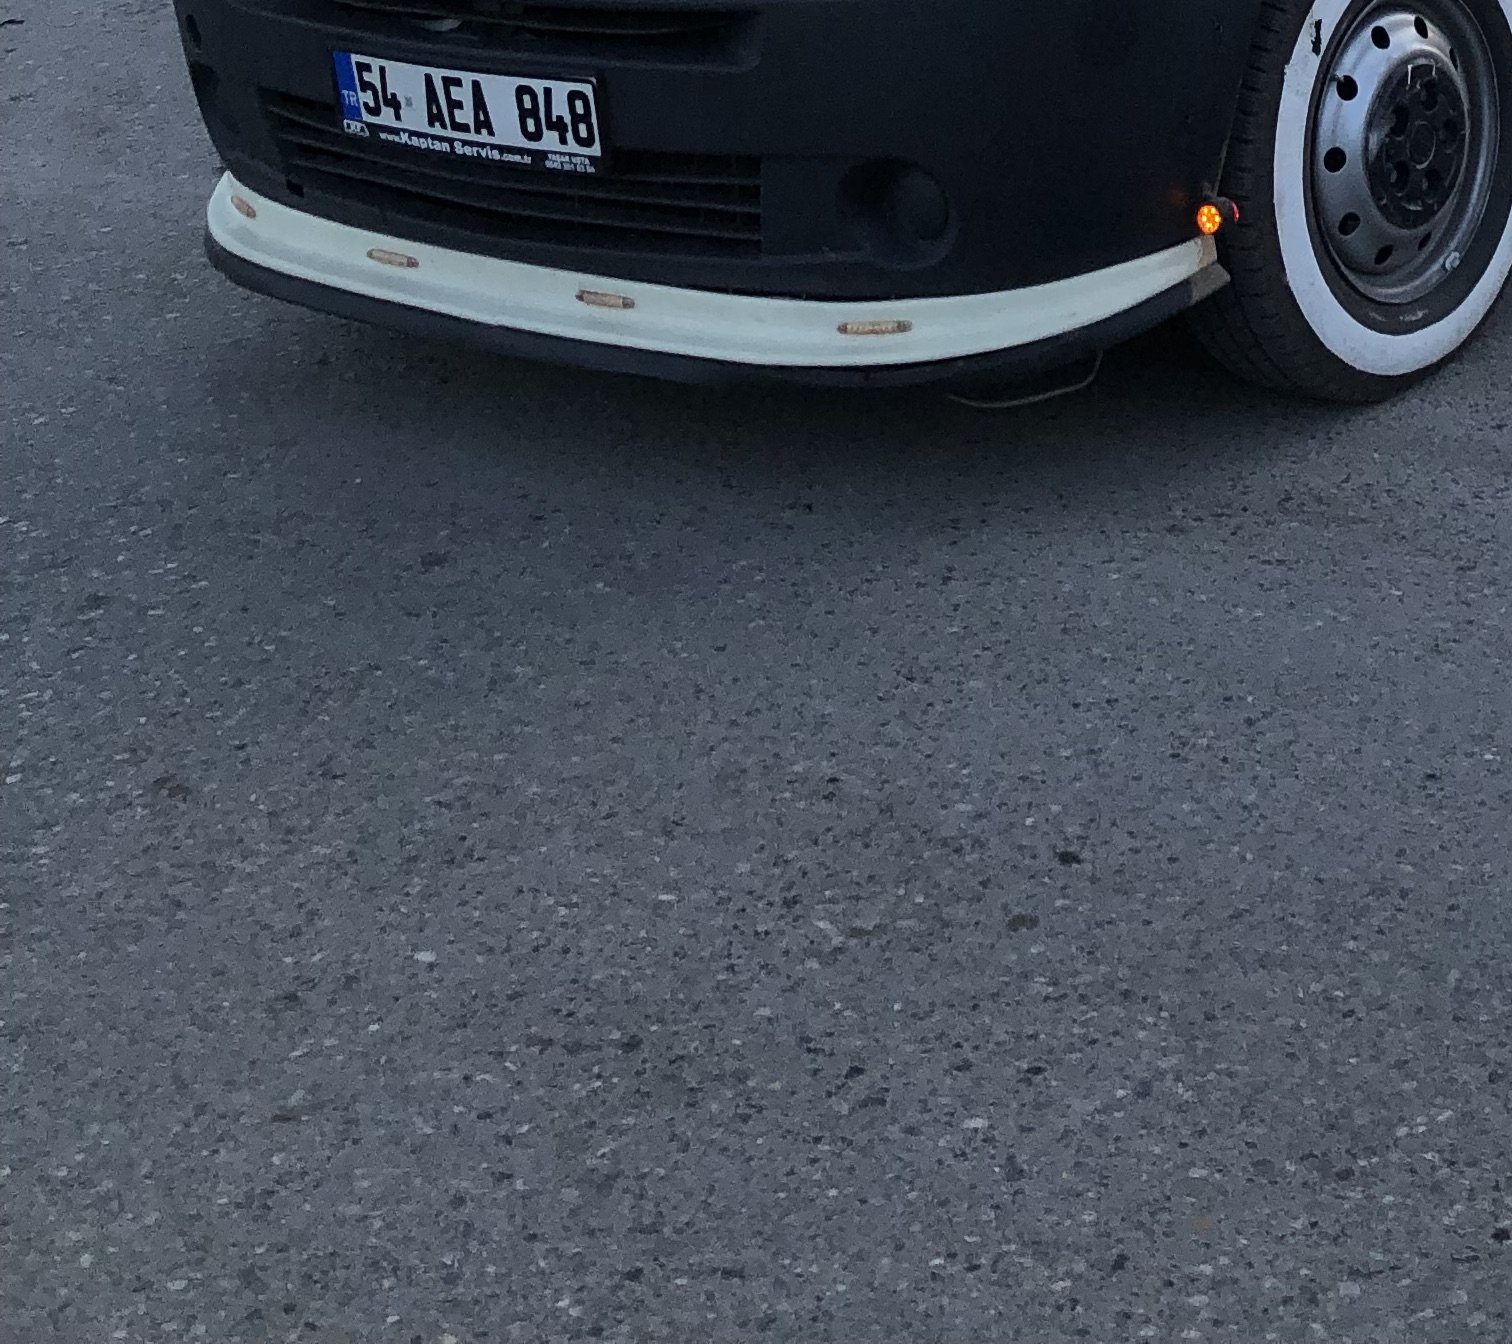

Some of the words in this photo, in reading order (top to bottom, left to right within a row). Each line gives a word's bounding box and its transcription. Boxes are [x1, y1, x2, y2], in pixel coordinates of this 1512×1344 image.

[340, 89, 359, 108] TR
[354, 60, 403, 123] 54
[424, 72, 496, 138] AEA
[514, 84, 596, 149] 848
